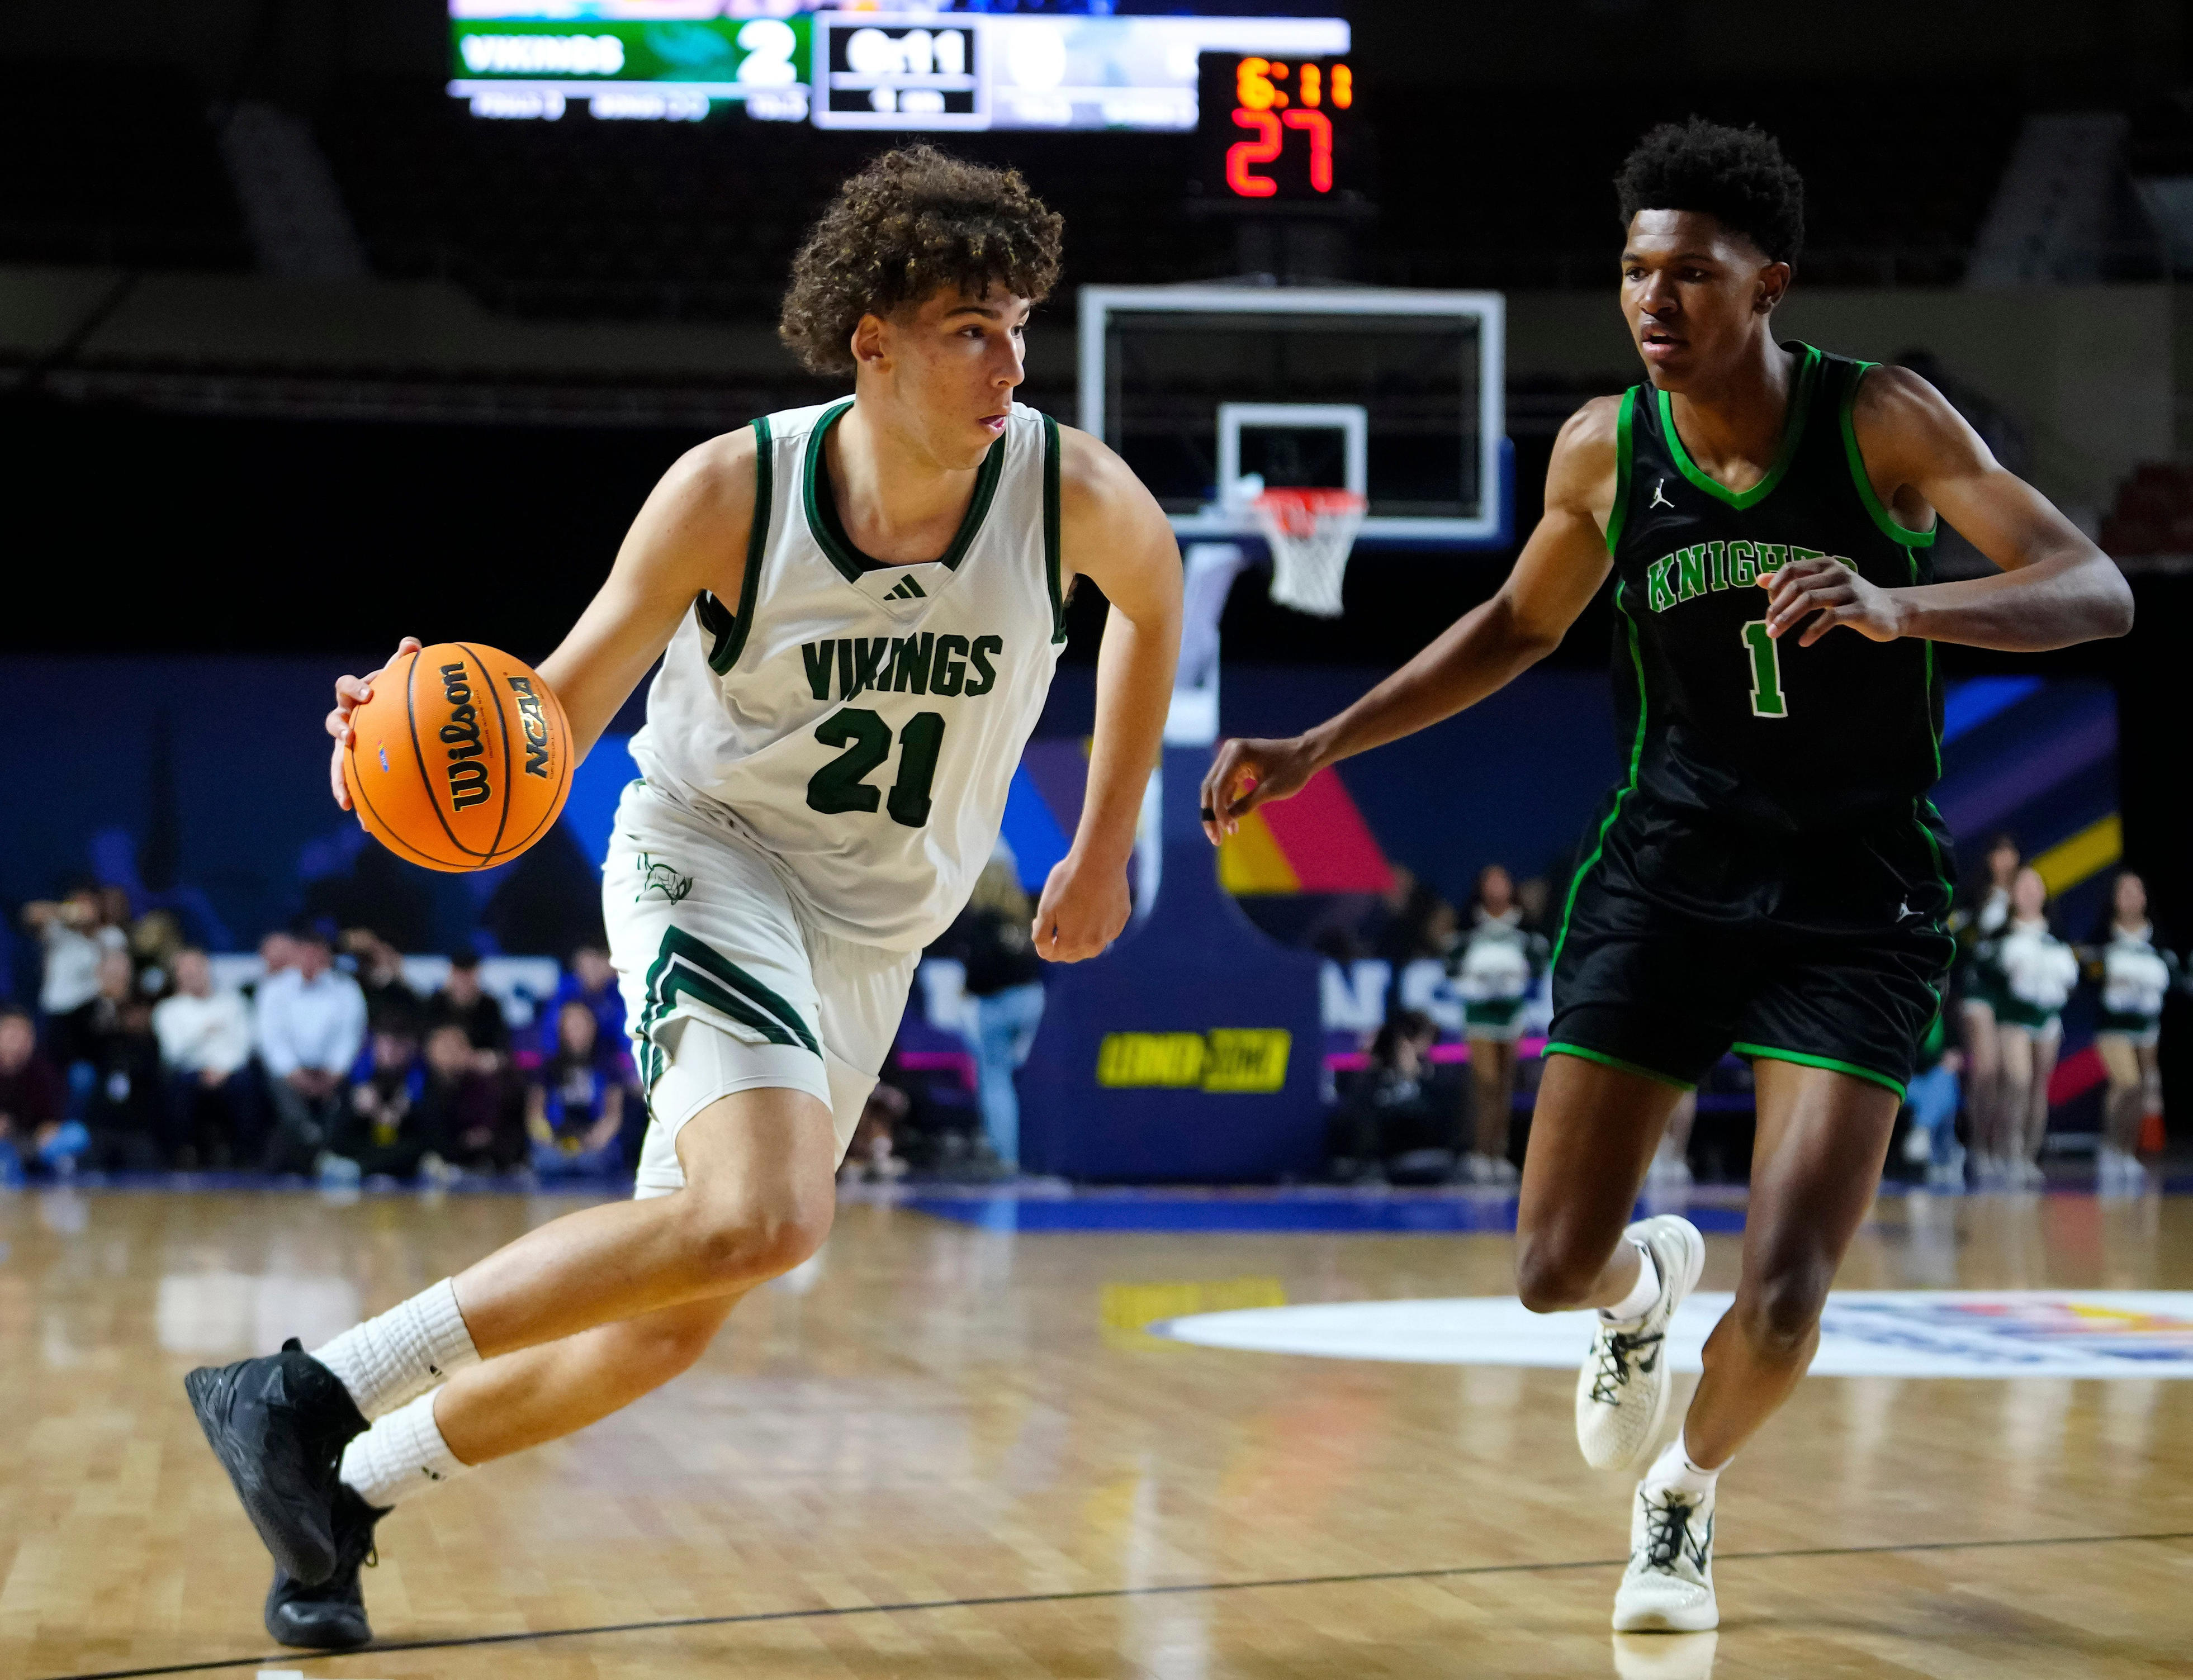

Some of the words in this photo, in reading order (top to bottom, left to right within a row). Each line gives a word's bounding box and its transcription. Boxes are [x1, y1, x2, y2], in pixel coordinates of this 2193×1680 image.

[462, 34, 624, 74] VIKINGS
[736, 18, 797, 85] 2
[1237, 57, 1352, 109] 6:11
[1226, 108, 1333, 197] 27
[1647, 540, 1858, 613] KNIGH
[802, 632, 1003, 702] VIKINGS
[1740, 619, 1789, 719] 1
[439, 661, 492, 812] Wilson
[508, 675, 550, 779] NCAA
[806, 708, 946, 828] 21
